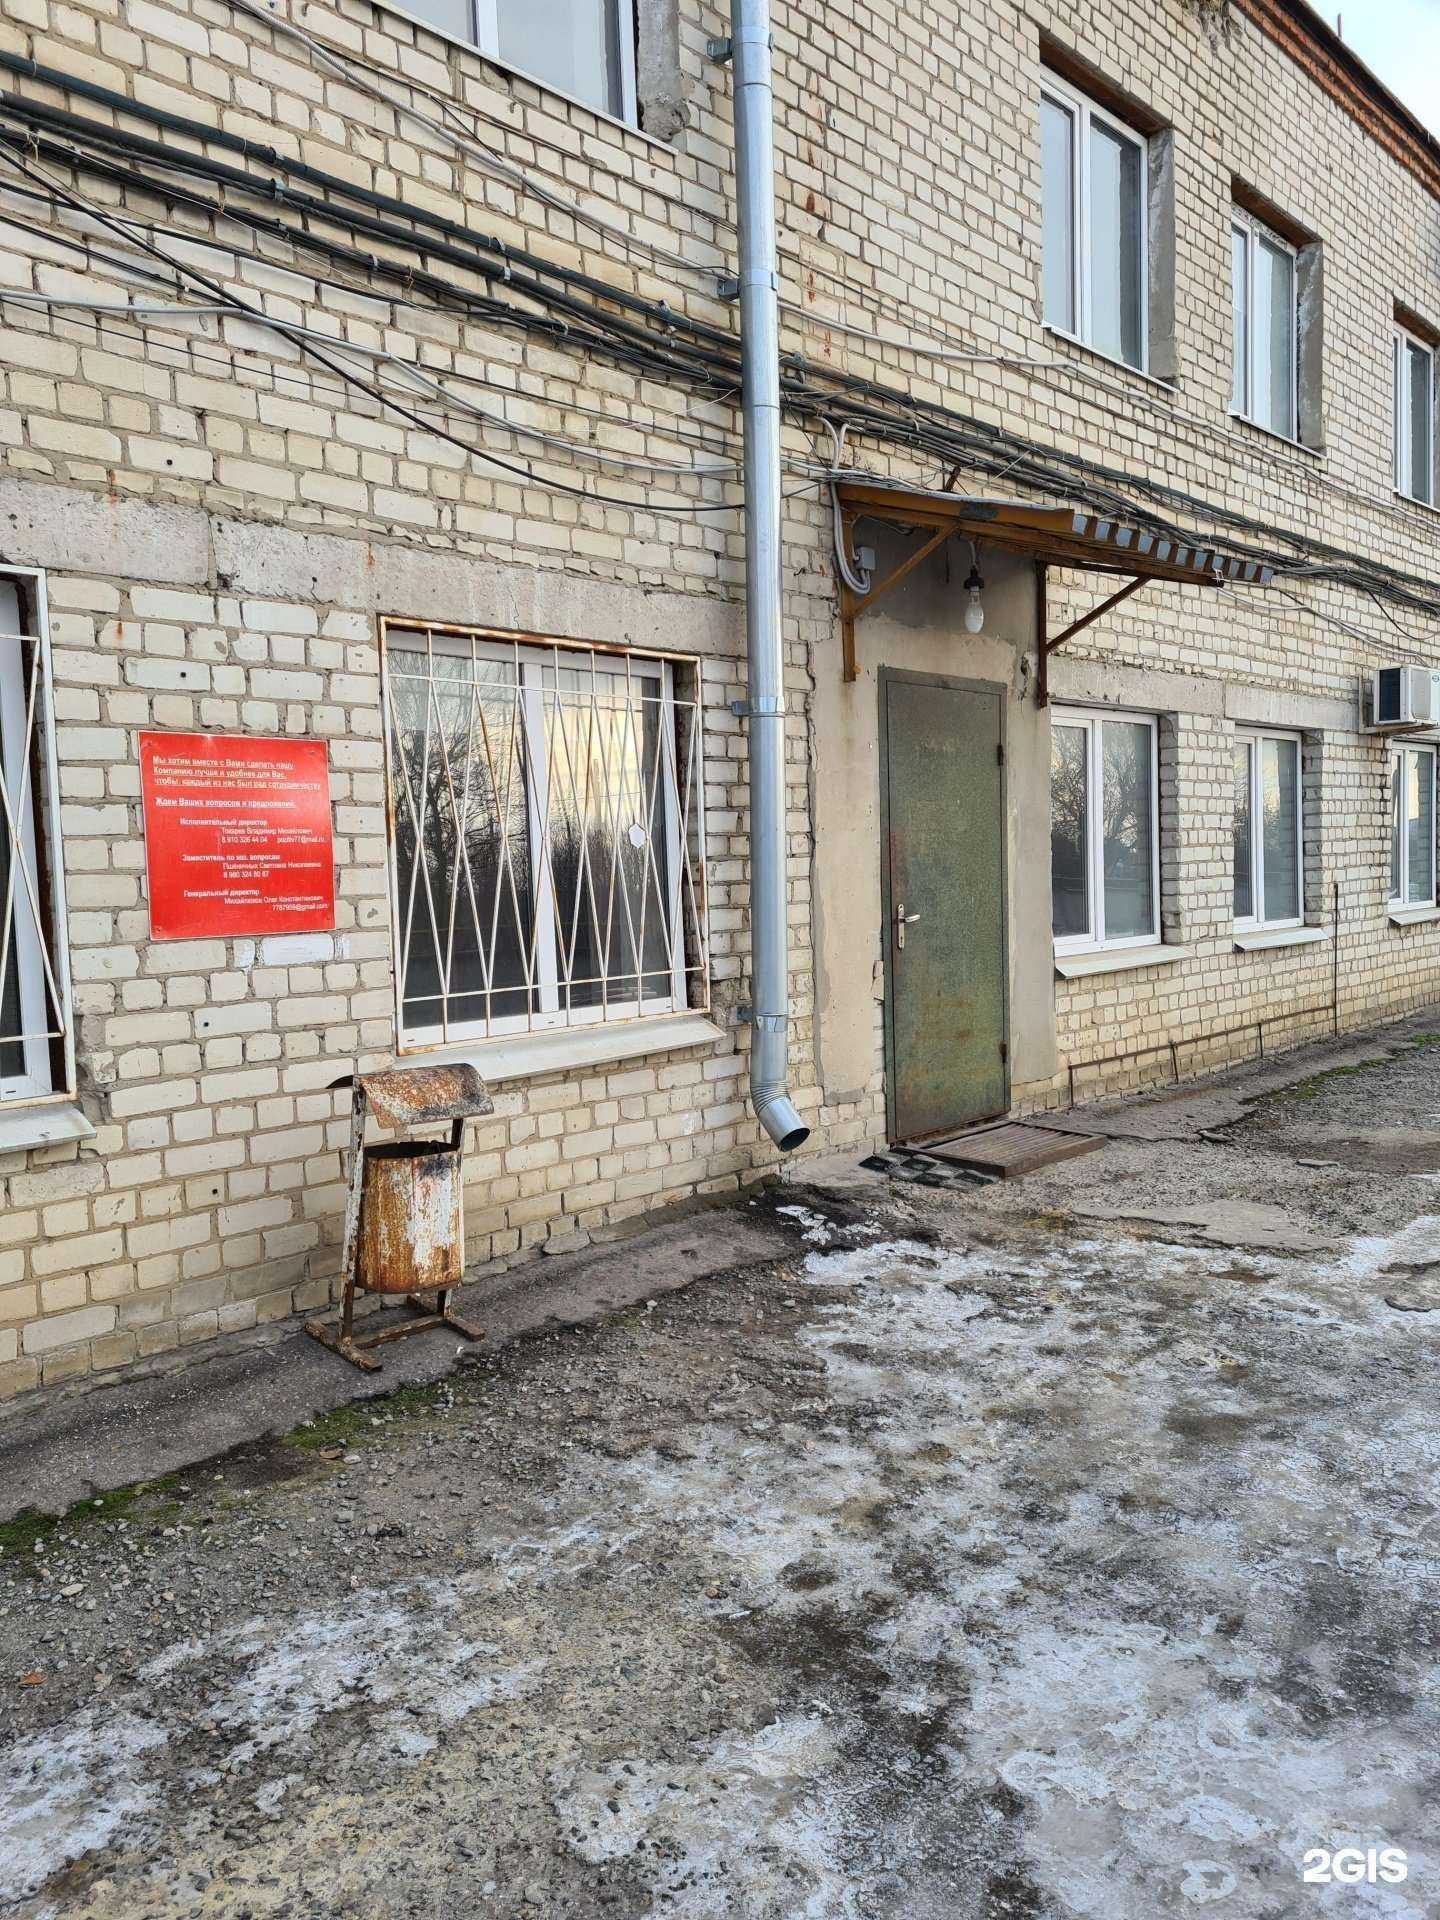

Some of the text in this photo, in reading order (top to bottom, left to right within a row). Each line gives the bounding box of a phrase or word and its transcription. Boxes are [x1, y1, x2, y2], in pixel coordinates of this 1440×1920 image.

[152, 755, 166, 765] Мы
[168, 758, 191, 766] хотим
[192, 759, 218, 767] вместе
[225, 759, 245, 768] Вами
[153, 766, 193, 775] Компанию
[194, 768, 218, 777] лучше
[238, 819, 267, 828] директор
[182, 854, 226, 862] Заместитель
[183, 888, 260, 898] Генеральный директор
